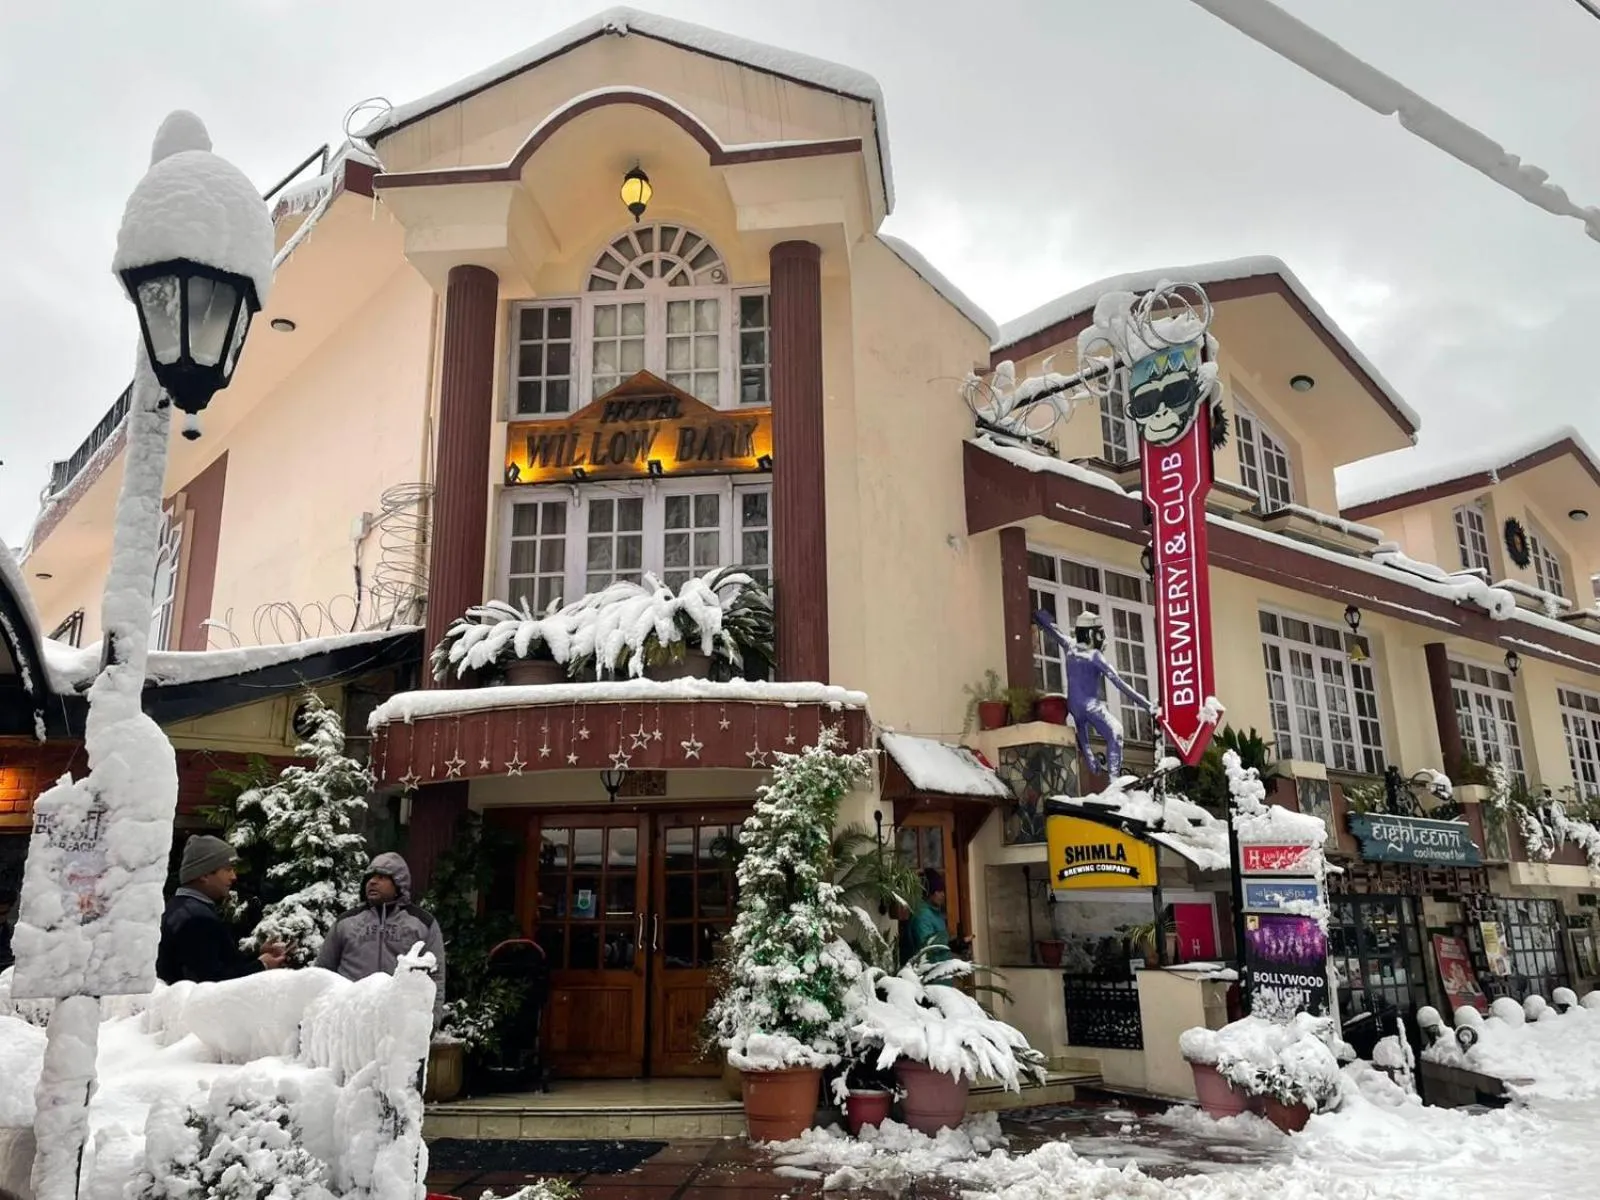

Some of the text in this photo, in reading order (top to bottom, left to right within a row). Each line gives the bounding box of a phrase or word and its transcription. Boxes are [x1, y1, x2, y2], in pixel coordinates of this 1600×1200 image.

[601, 396, 682, 423] HOTEL
[527, 415, 759, 468] WILLOW BANK
[1161, 451, 1194, 706] BREWERY & CLUB
[1065, 843, 1127, 865] SHIMLA
[1063, 863, 1131, 877] BREWING COMPANY
[1253, 971, 1324, 988] BOLLYWOOD
